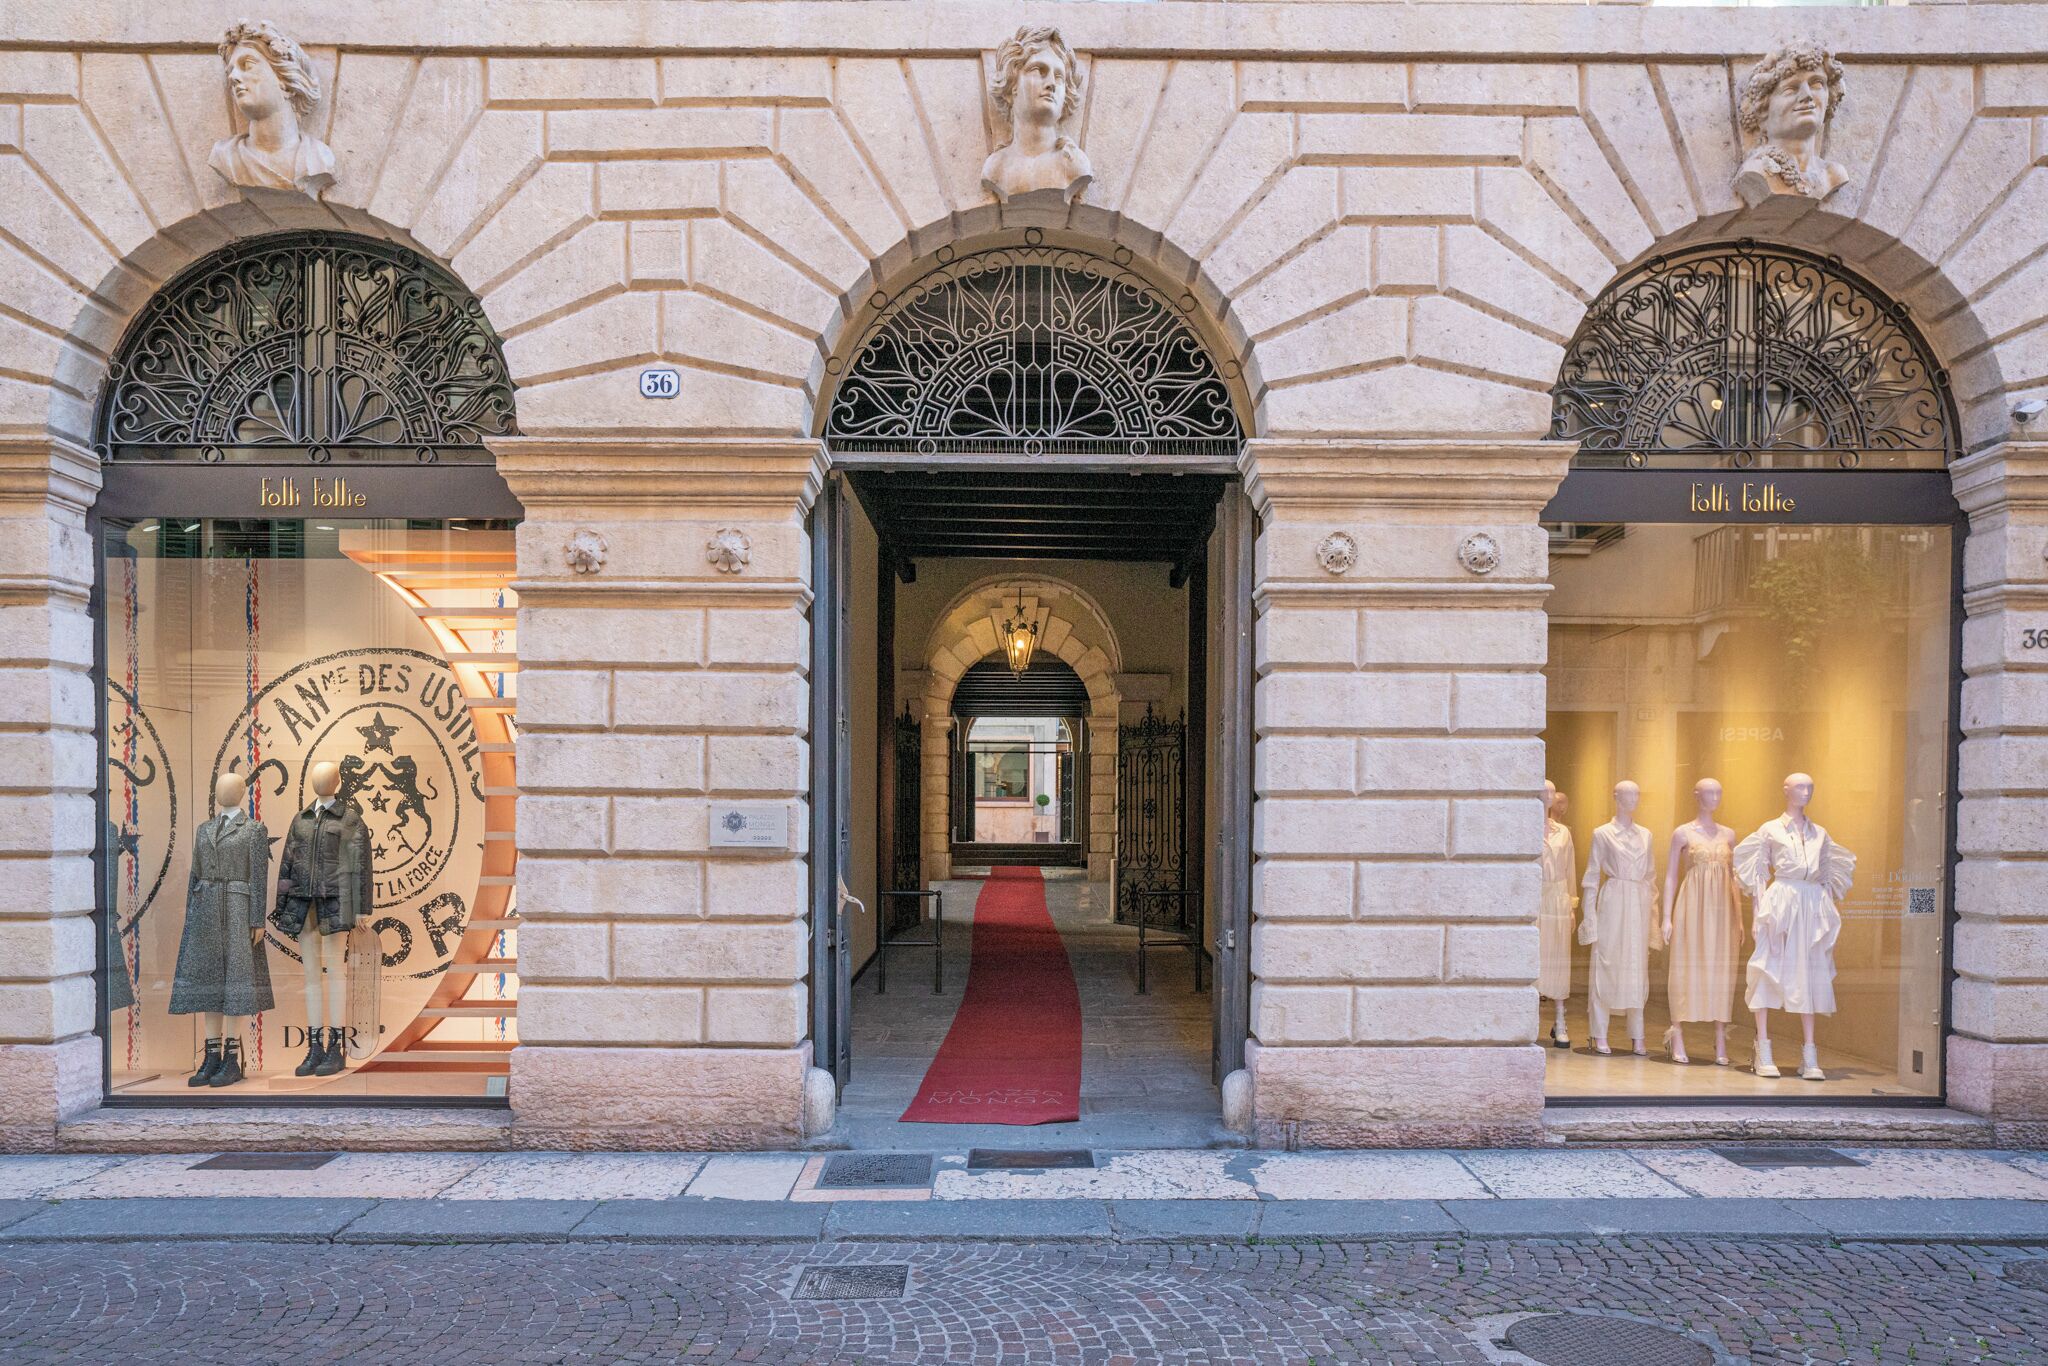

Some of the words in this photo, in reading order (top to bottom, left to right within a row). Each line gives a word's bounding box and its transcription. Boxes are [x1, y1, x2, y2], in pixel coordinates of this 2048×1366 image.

[647, 374, 672, 393] 36
[261, 477, 300, 506] Folli
[313, 477, 367, 506] Follie
[1691, 482, 1730, 512] Folli
[1743, 482, 1796, 512] Follie
[2022, 629, 2048, 649] 36
[359, 663, 412, 696] DES
[388, 878, 406, 897] LA
[406, 845, 444, 887] FORCE
[282, 1025, 362, 1049] DIOR
[928, 1096, 1063, 1105] MONGA
[932, 1089, 1064, 1097] PALAZZO
